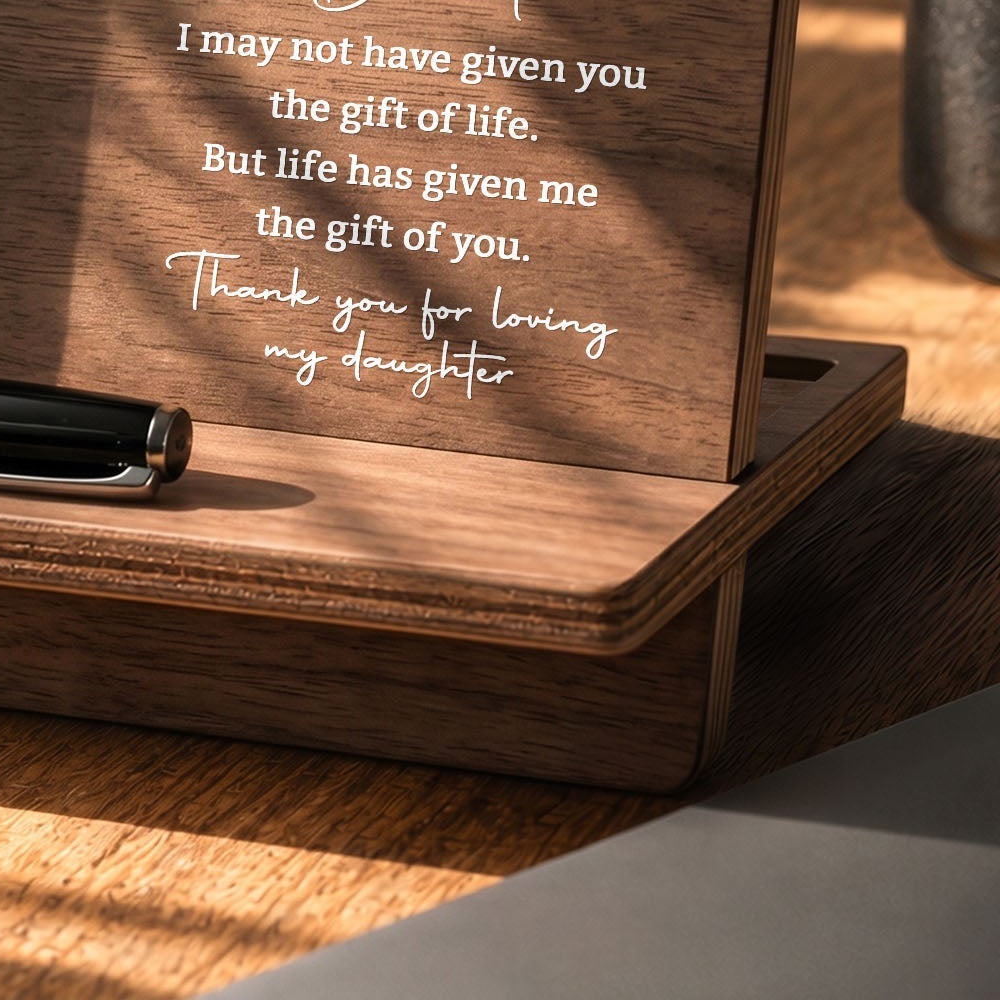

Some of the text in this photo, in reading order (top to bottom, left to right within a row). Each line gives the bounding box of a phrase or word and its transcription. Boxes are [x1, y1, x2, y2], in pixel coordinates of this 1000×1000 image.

[176, 22, 647, 93] I may not have given you
[268, 87, 539, 142] the gift of life.
[201, 142, 599, 208] But life has given me
[255, 205, 531, 264] the gift of you.
[165, 249, 619, 360] Thank you for loving
[264, 329, 515, 400] my daughter
